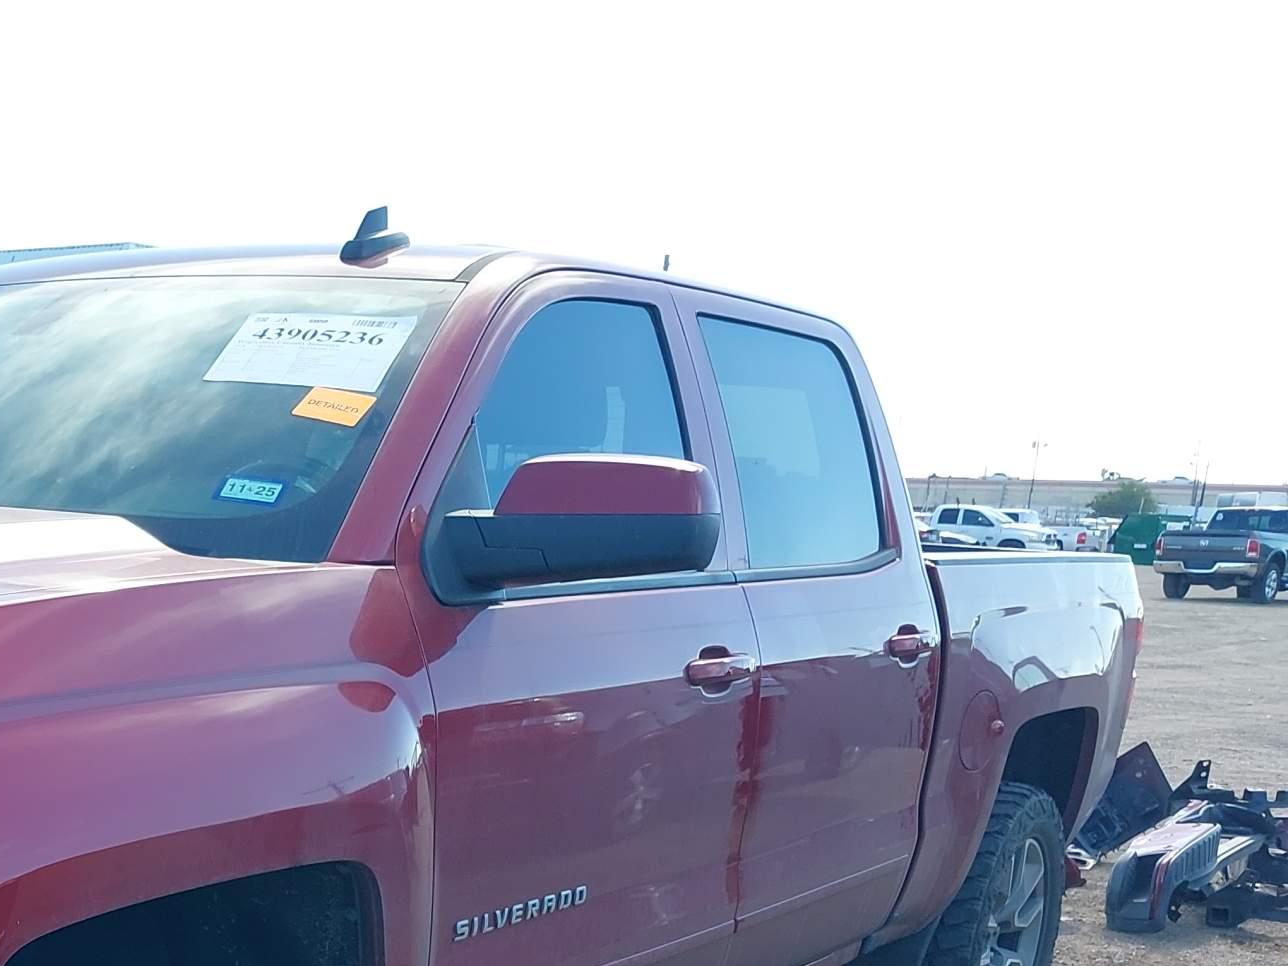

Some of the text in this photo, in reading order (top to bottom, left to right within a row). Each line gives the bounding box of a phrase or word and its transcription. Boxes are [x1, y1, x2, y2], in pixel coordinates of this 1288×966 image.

[252, 327, 384, 346] 43905236
[307, 399, 359, 413] DETAILED
[454, 885, 587, 942] SILVERADO
